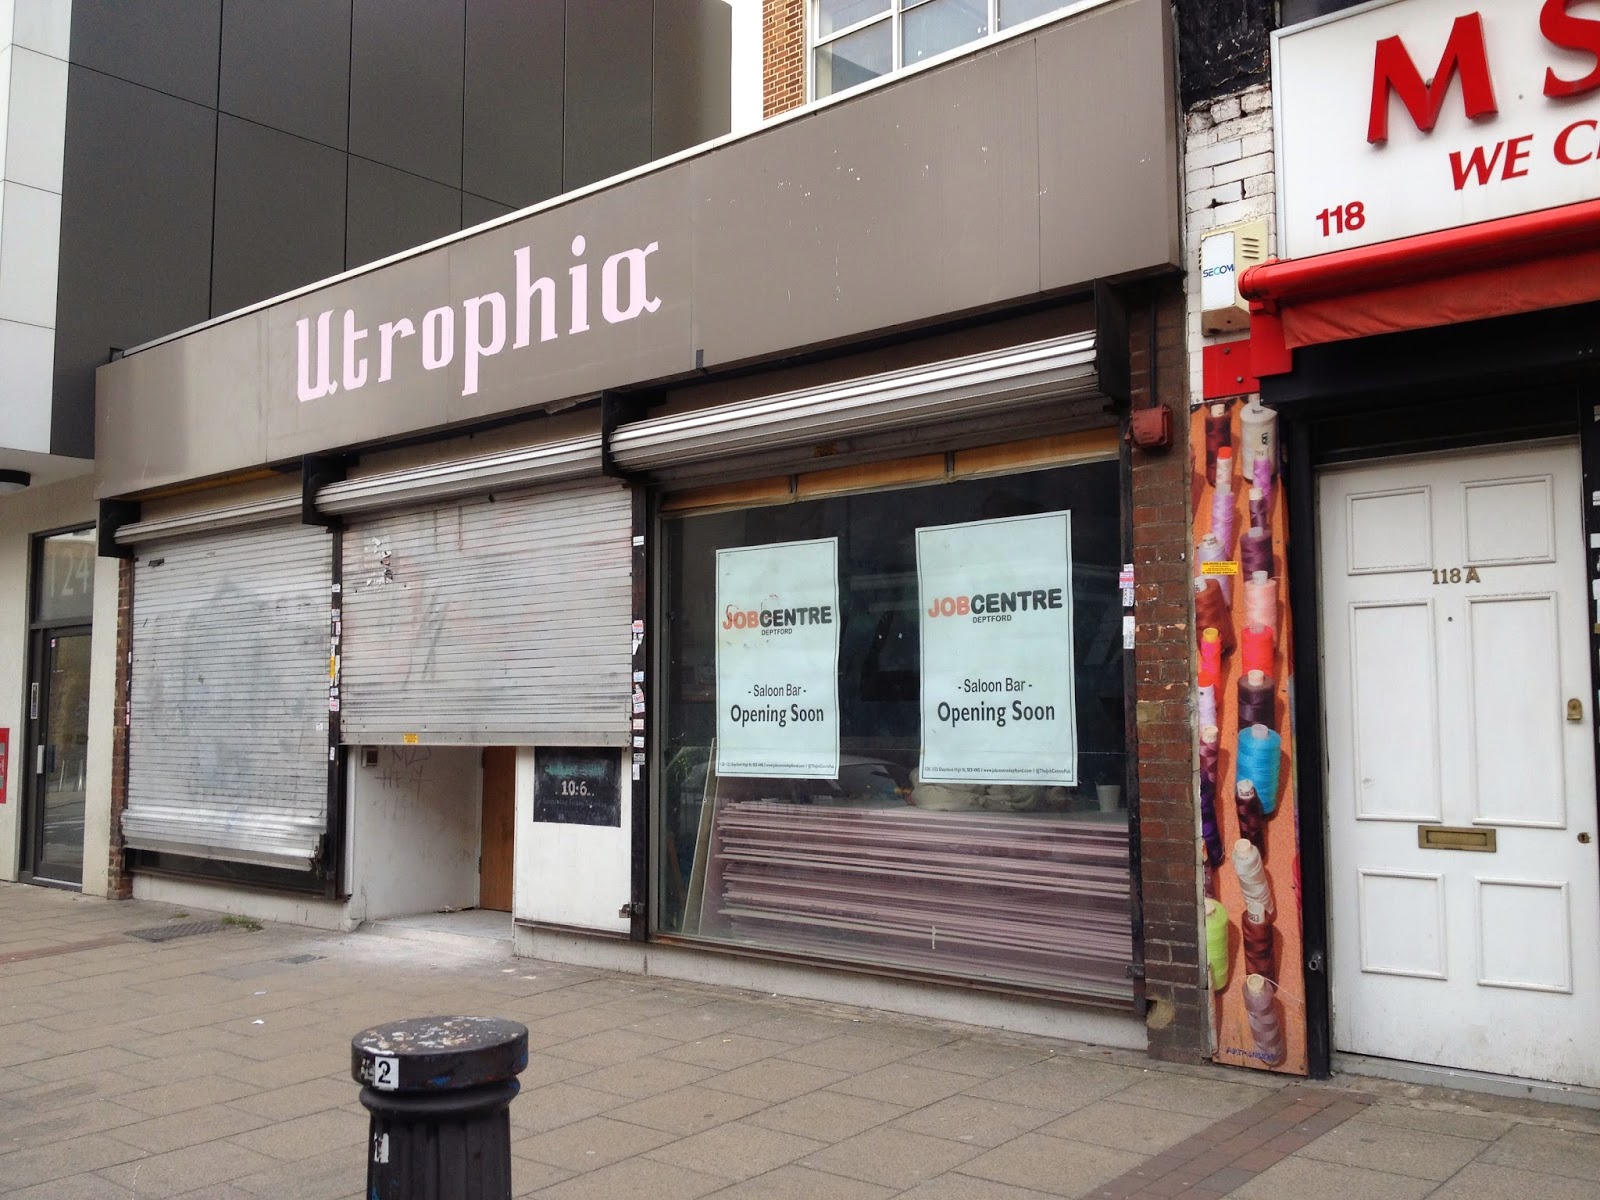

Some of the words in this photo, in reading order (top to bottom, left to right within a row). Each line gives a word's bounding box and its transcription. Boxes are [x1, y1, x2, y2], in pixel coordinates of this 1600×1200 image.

[1449, 134, 1534, 191] WE
[1553, 120, 1600, 165] C
[1316, 201, 1366, 237] 118
[1203, 264, 1235, 278] SECOM
[296, 235, 662, 403] Utrophia
[928, 588, 1063, 618] JOBCENTRE
[723, 606, 832, 630] JOBCENTRE
[972, 614, 1012, 623] DEPTFORD
[761, 628, 793, 636] DEPTFORD
[753, 684, 784, 697] Saloon
[786, 683, 802, 697] Bar
[963, 678, 1002, 693] Saloon
[1005, 677, 1026, 692] Bar
[730, 704, 787, 728] Opening
[790, 703, 824, 722] Soon
[937, 700, 1007, 728] Opening
[1012, 700, 1055, 721] Soon
[378, 1060, 391, 1084] 2
